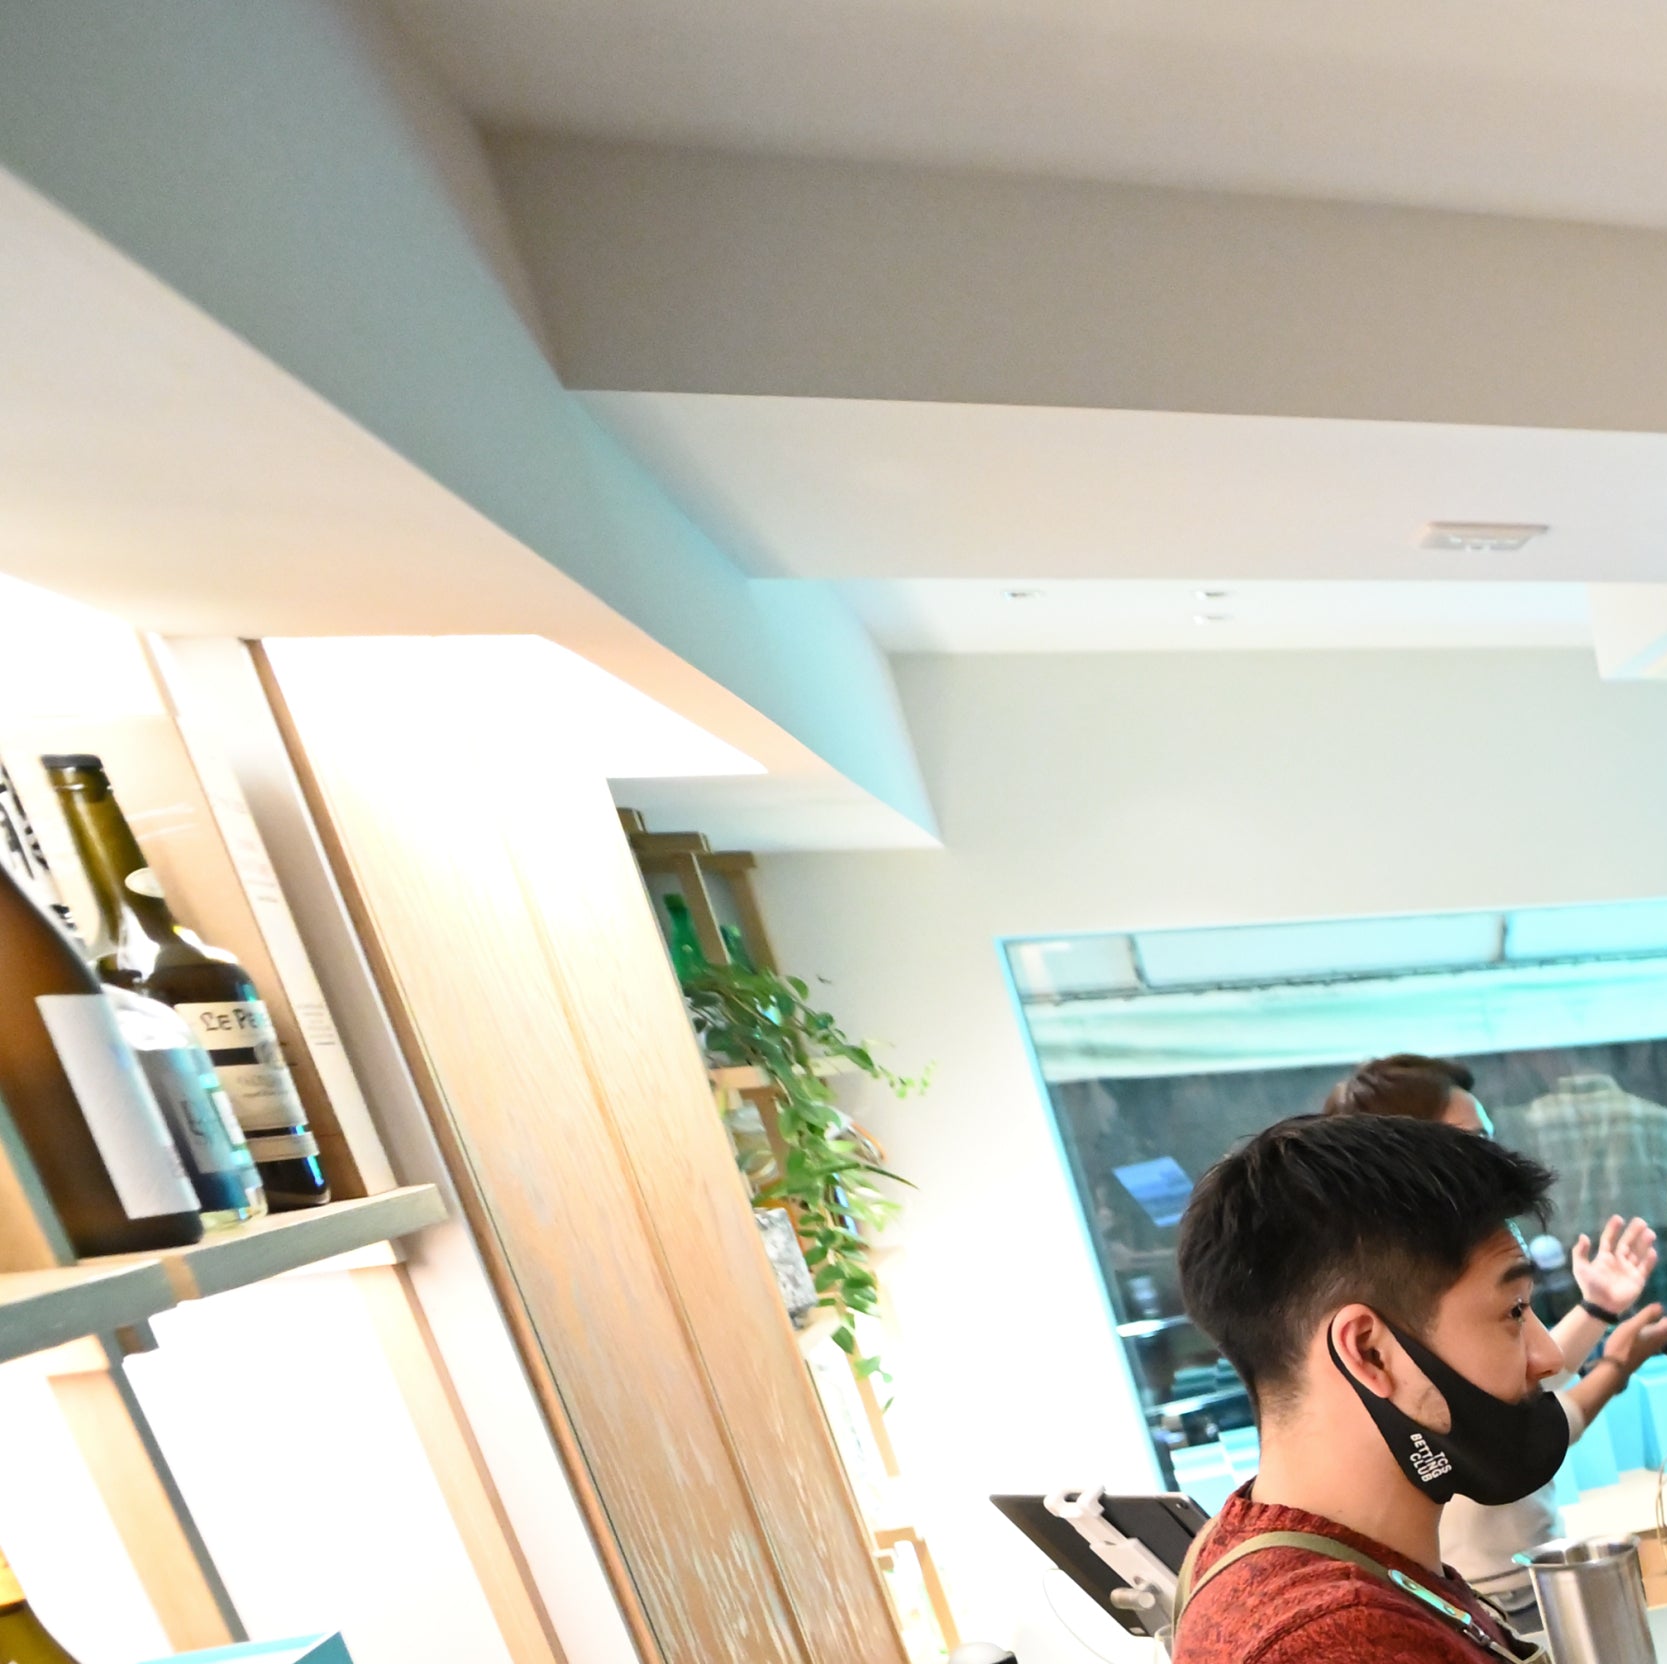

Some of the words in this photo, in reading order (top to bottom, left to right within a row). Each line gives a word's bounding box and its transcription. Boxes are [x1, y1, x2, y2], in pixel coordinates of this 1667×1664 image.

[1410, 1433, 1442, 1478] BETTING
[1410, 1453, 1433, 1482] CLUB
[1434, 1451, 1452, 1474] TCS
